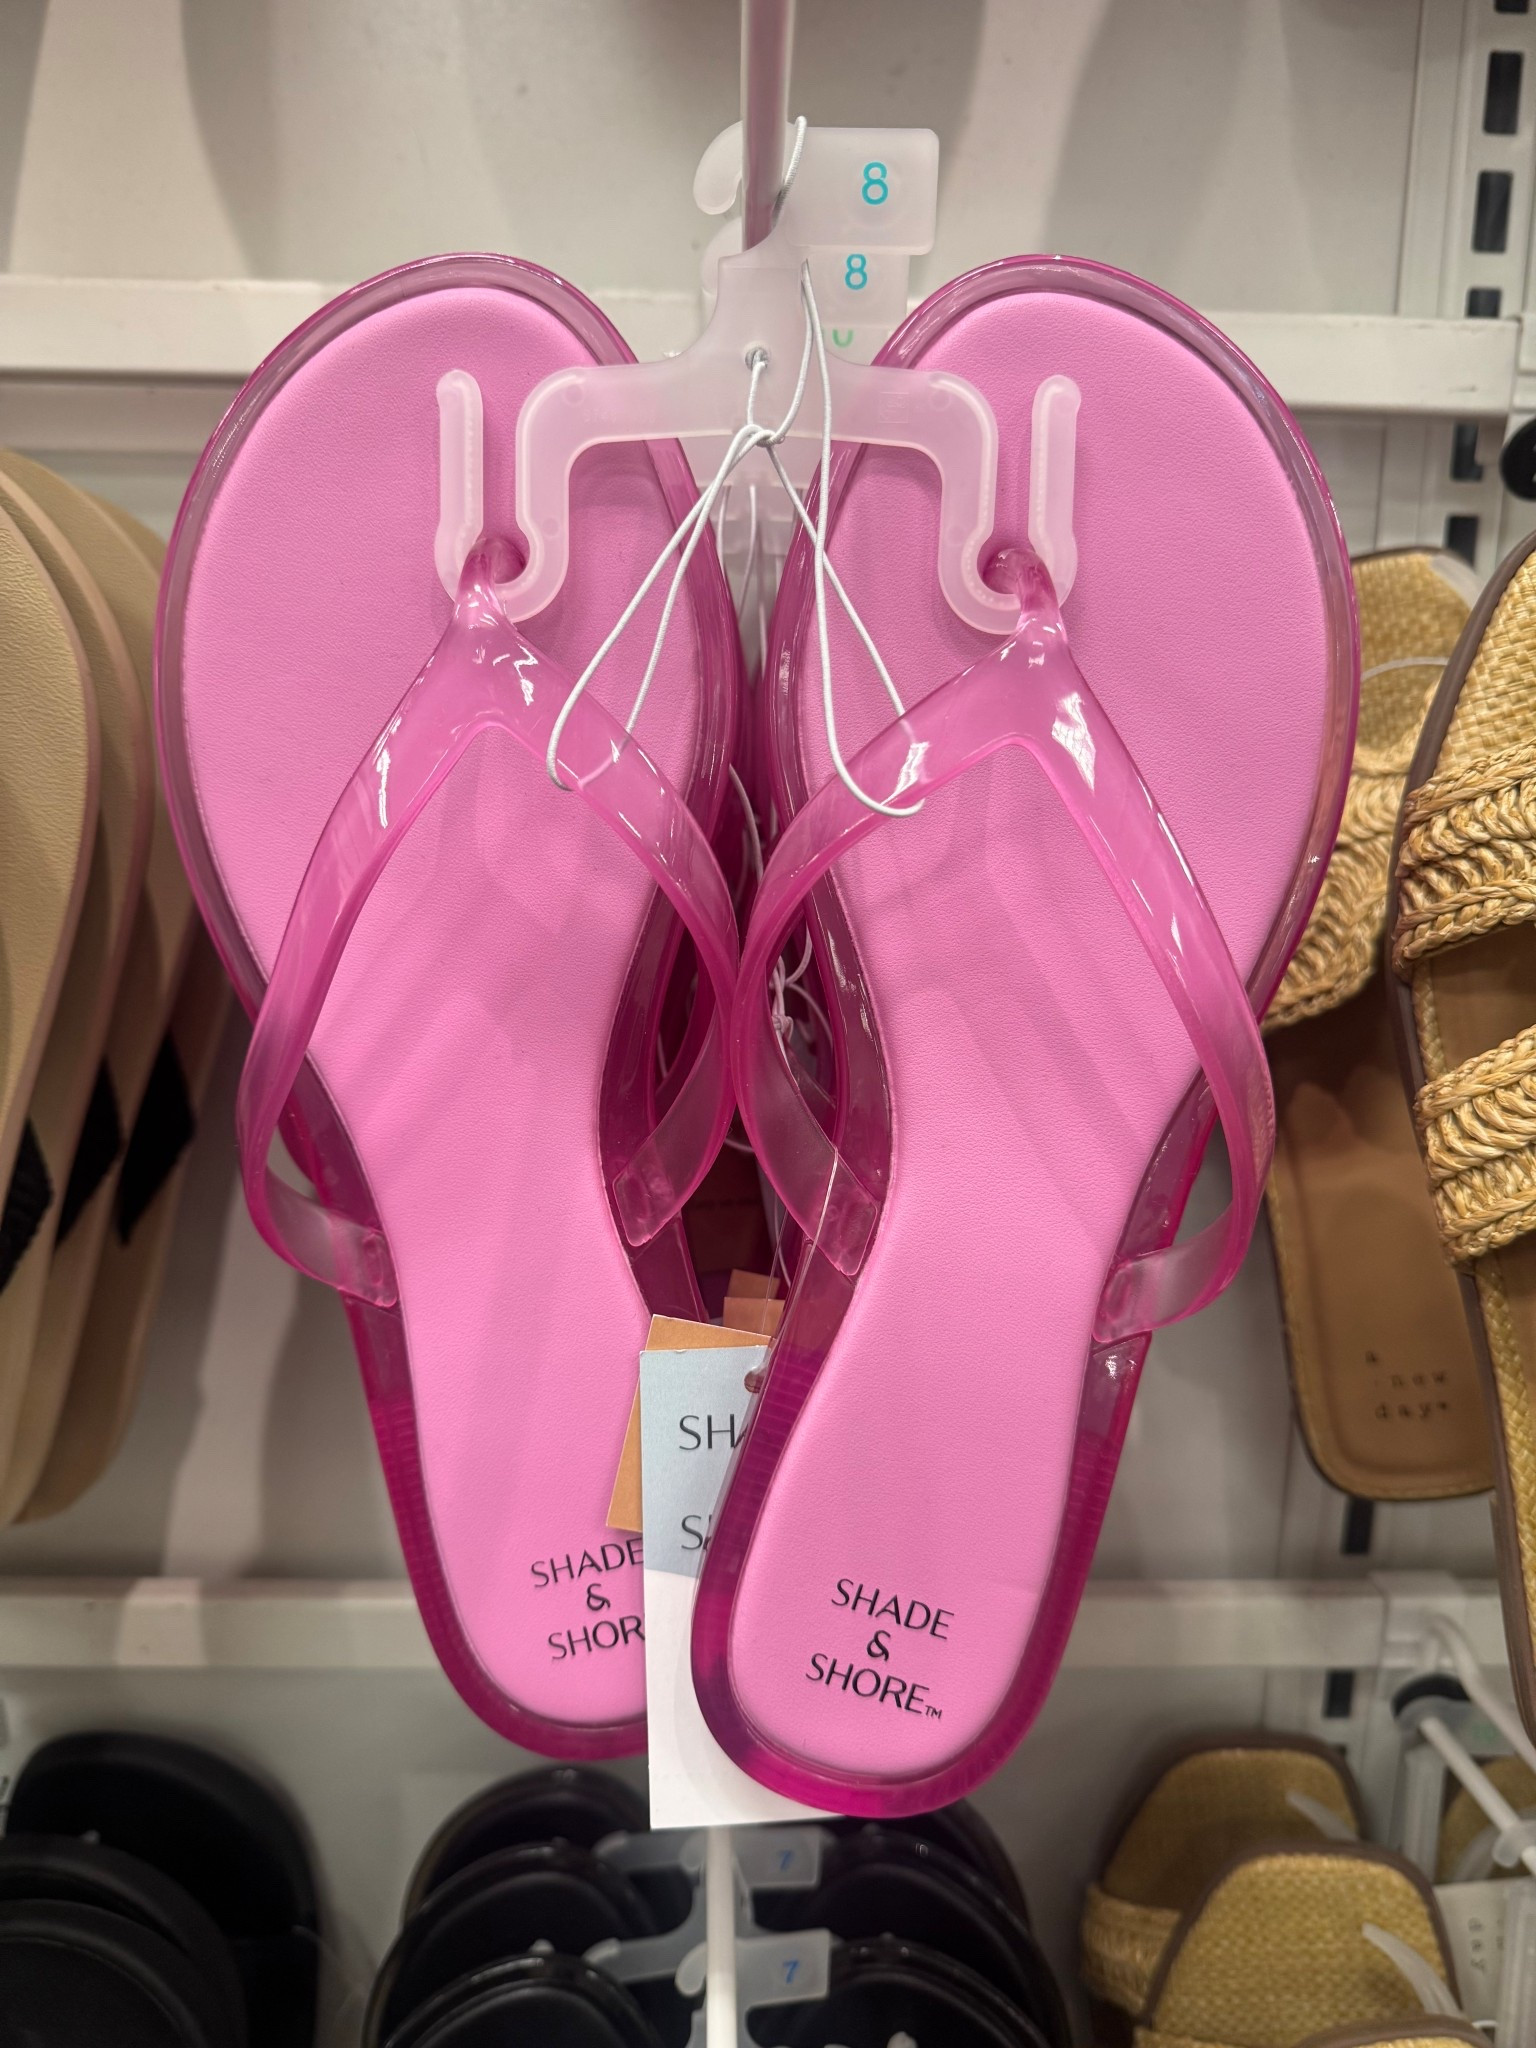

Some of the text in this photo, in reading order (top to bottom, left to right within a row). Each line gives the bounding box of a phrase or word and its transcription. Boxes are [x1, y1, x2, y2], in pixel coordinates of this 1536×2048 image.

[861, 161, 889, 206] 8
[844, 253, 868, 290] 8
[530, 1537, 644, 1588] SHADE
[586, 1583, 611, 1611] &
[831, 1578, 955, 1640] SHADE
[866, 1629, 892, 1662] &
[783, 1959, 799, 1985] 7
